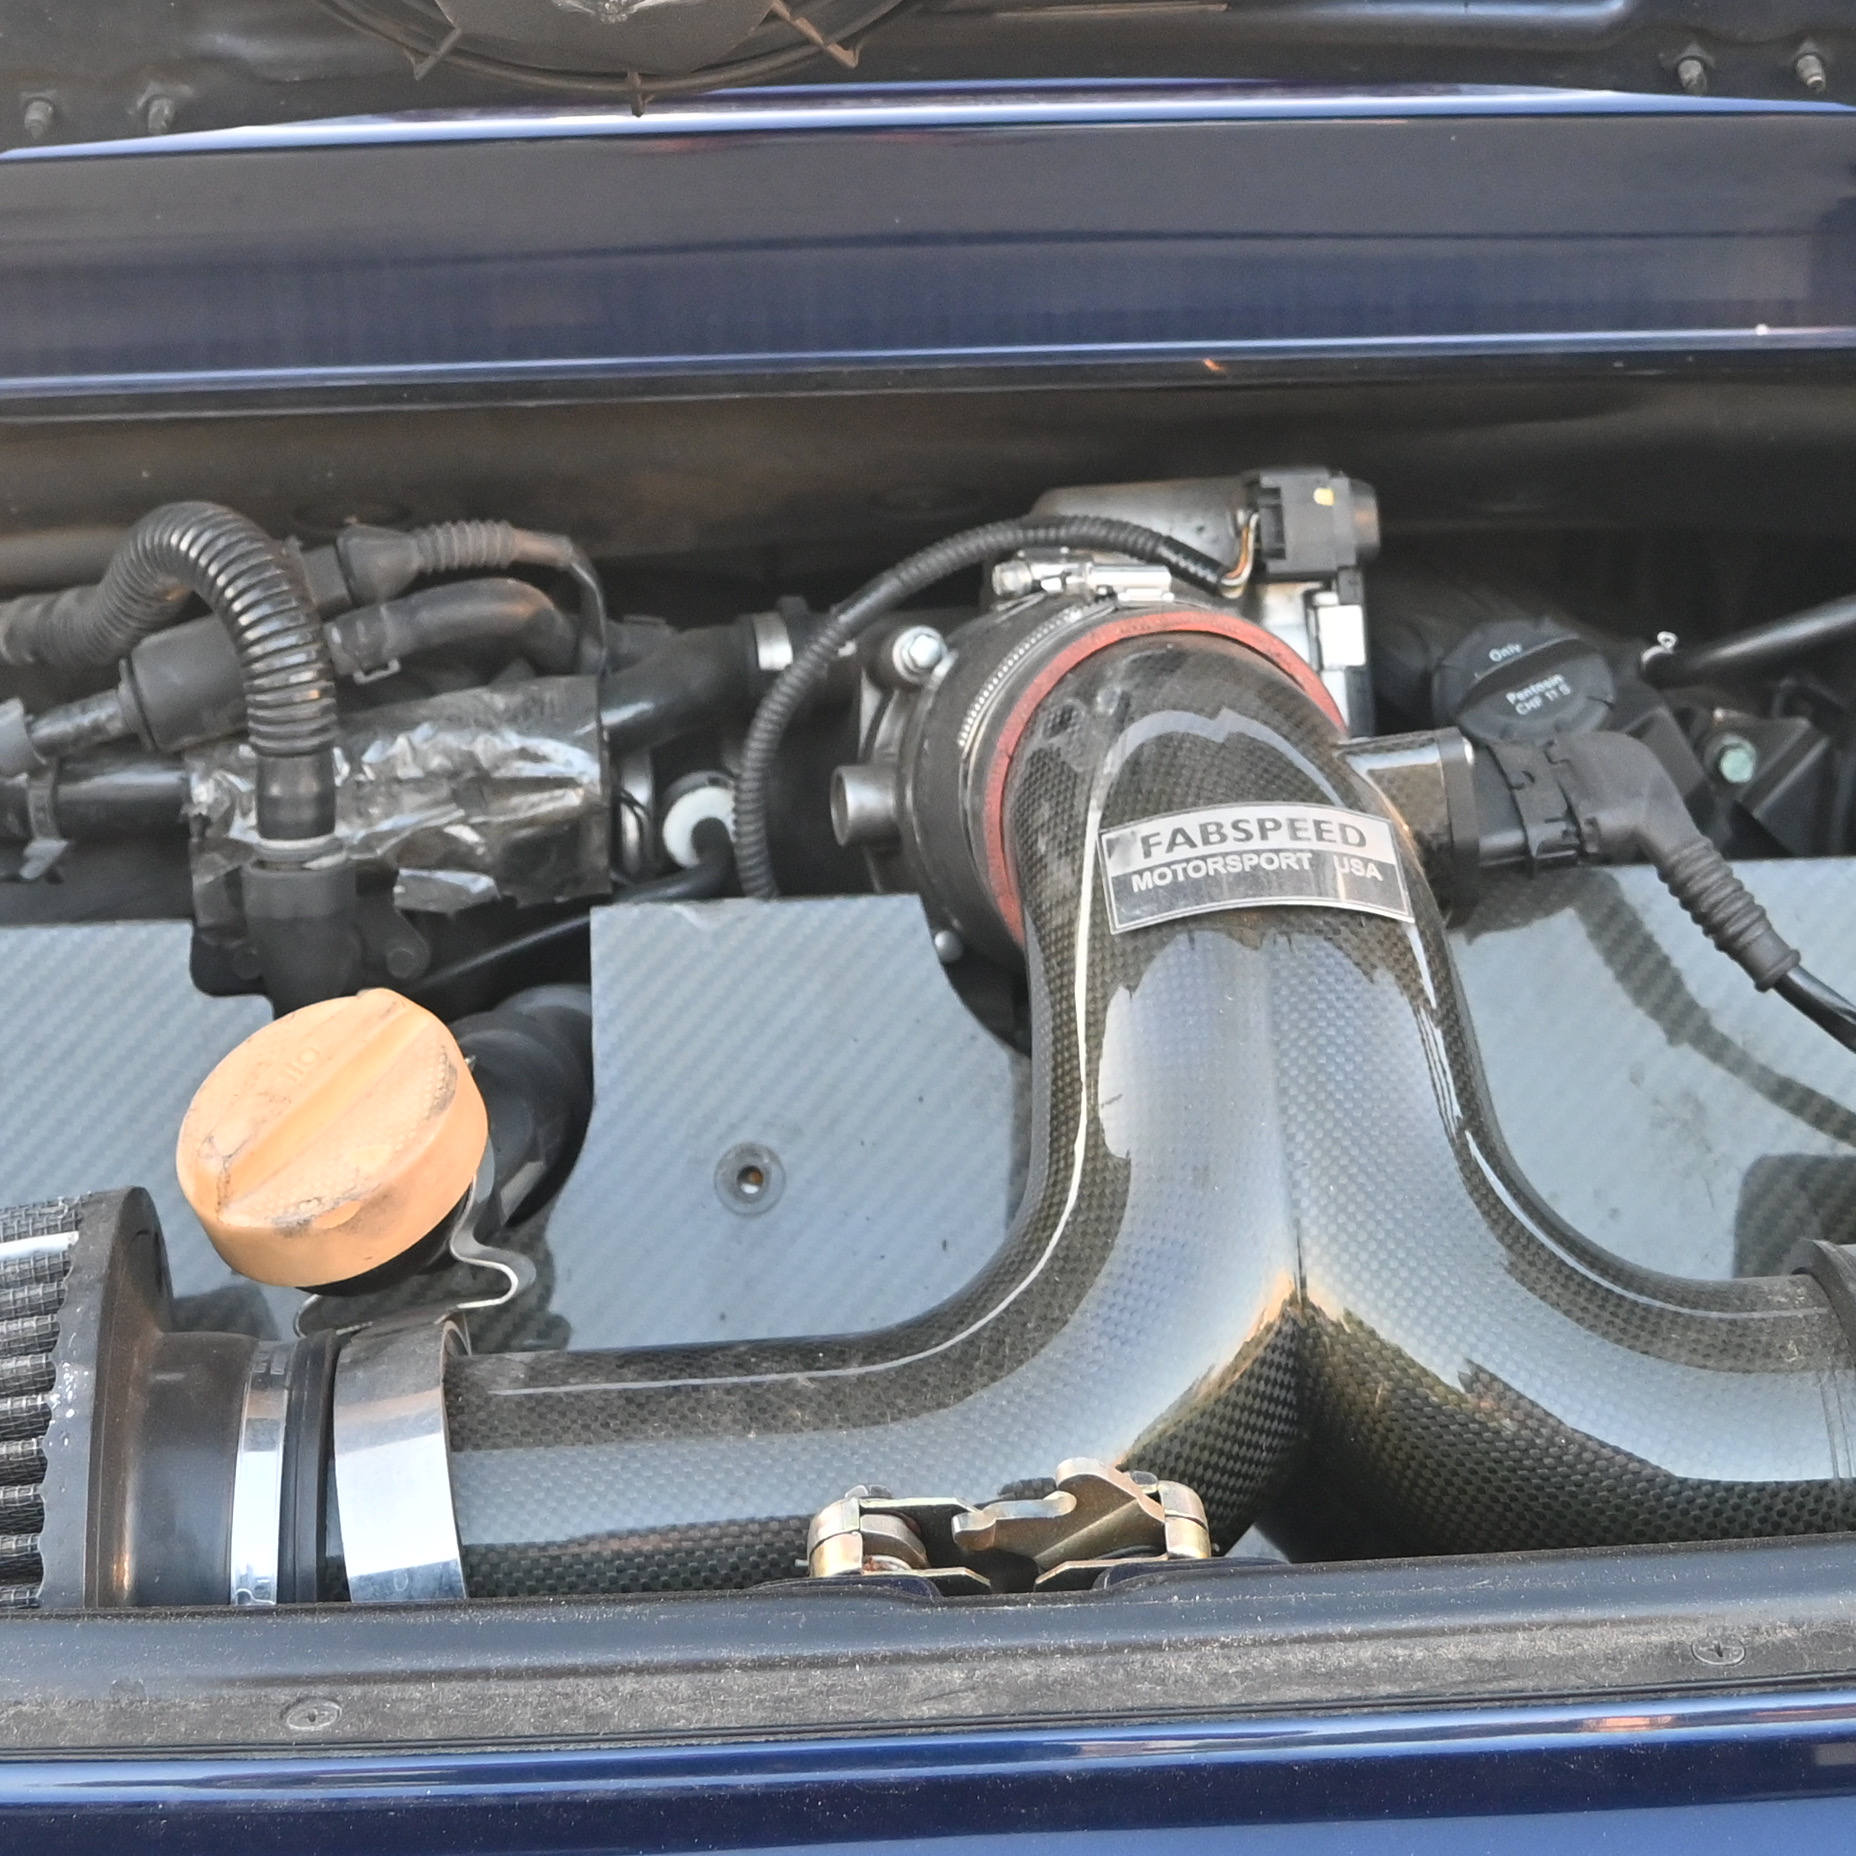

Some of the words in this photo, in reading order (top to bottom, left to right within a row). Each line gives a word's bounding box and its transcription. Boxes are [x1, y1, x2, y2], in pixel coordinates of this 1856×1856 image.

[1141, 817, 1367, 859] FABSPEED
[1131, 851, 1313, 894] MOTORSPORT
[1334, 854, 1383, 883] USA
